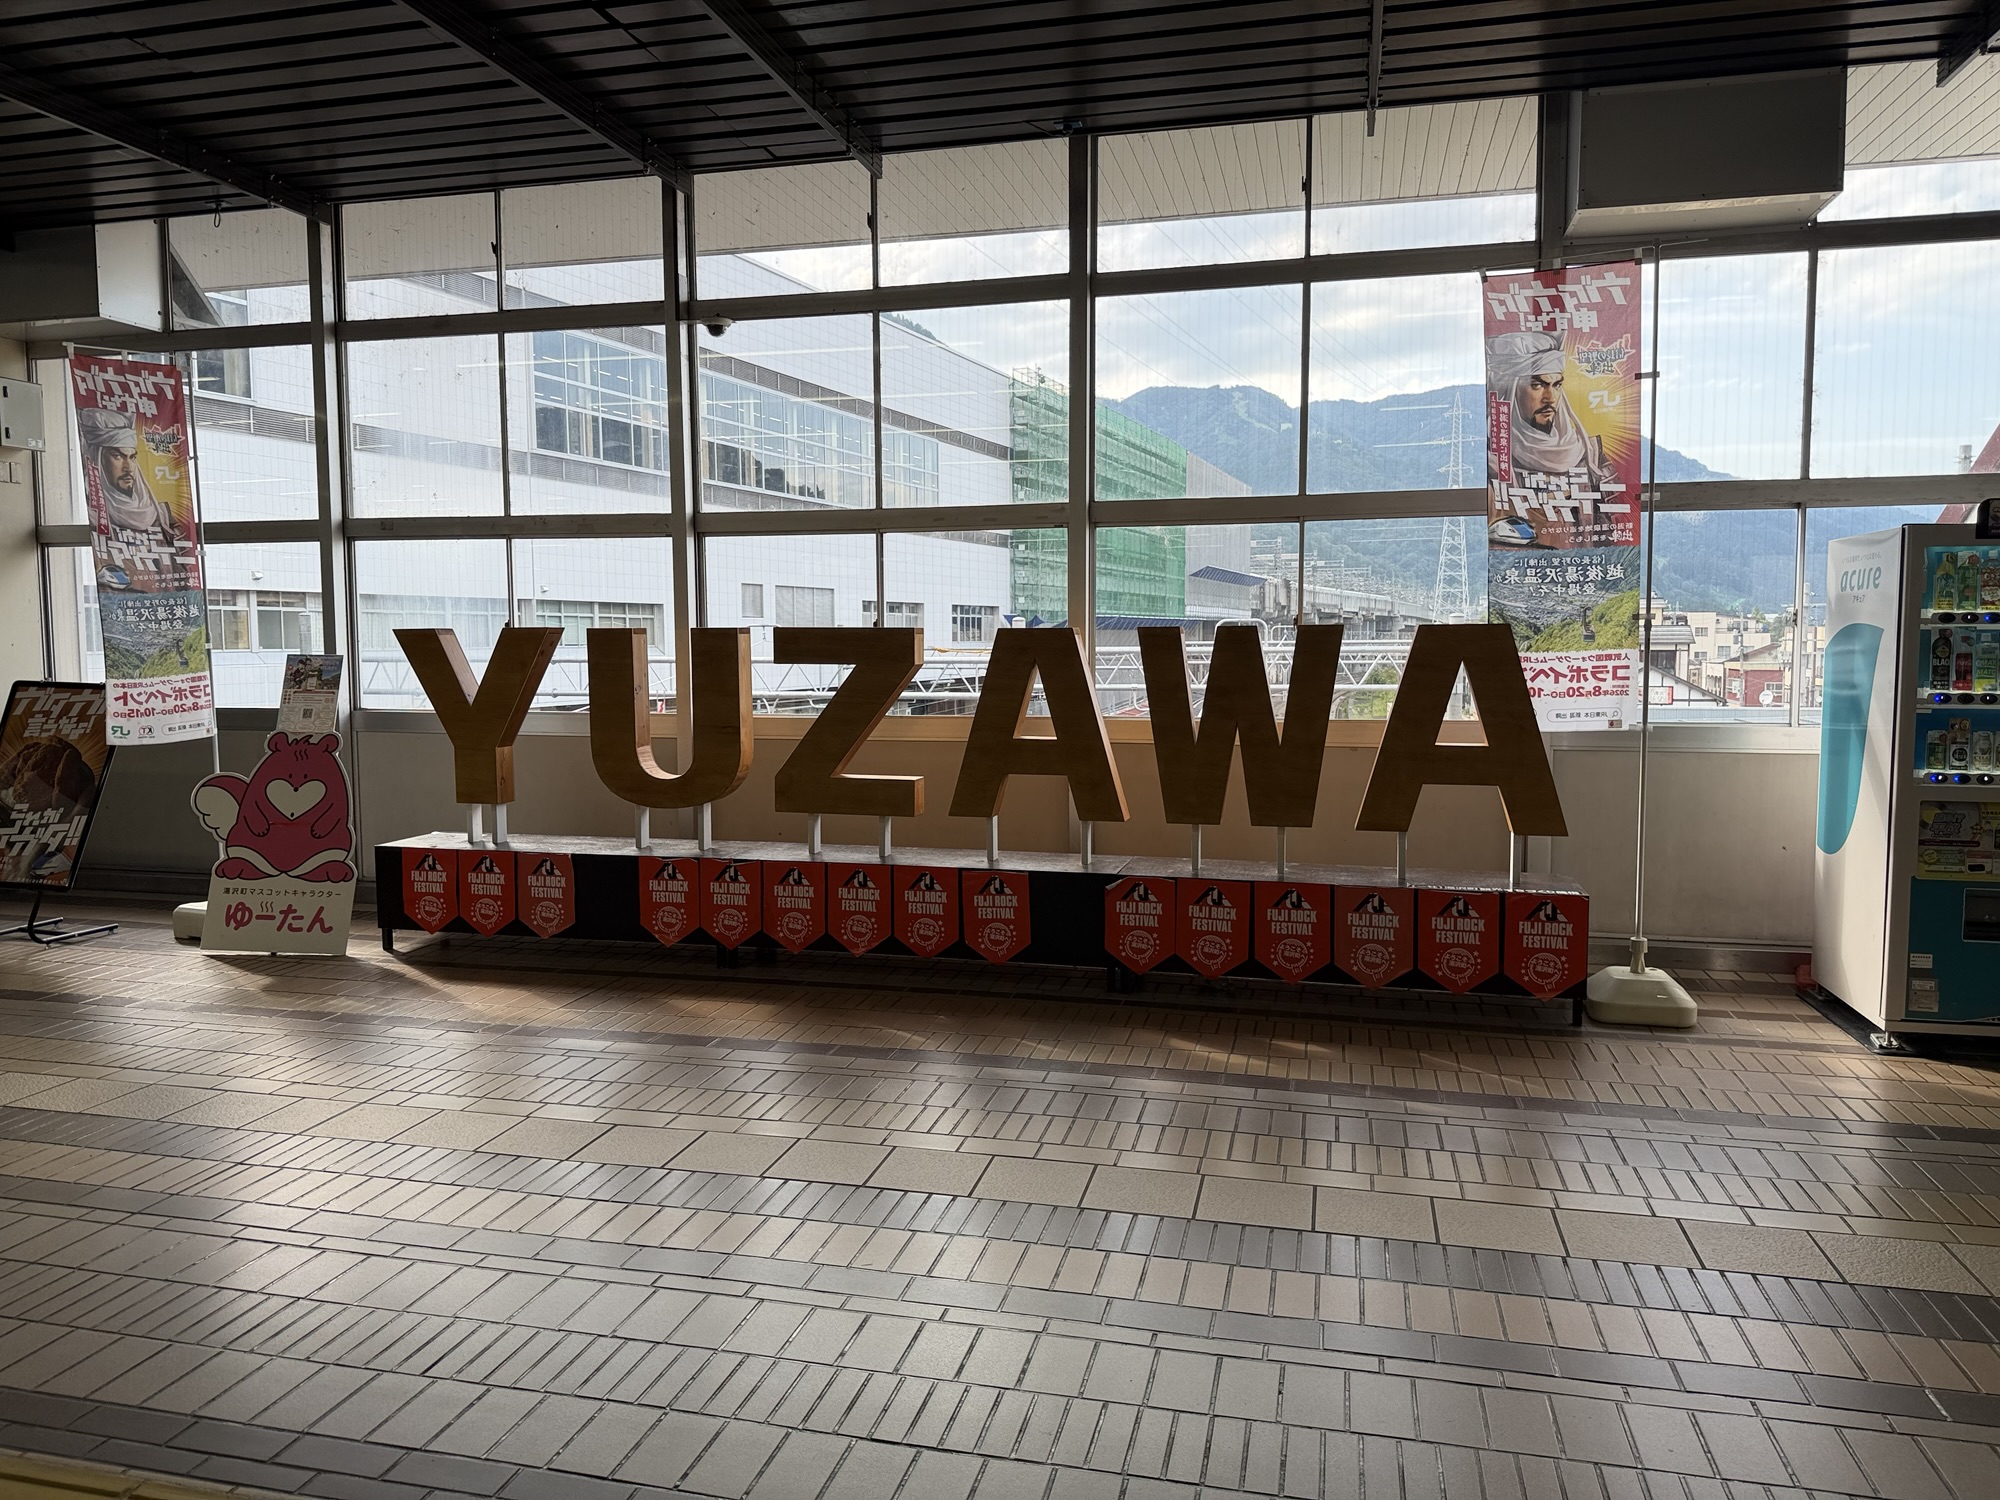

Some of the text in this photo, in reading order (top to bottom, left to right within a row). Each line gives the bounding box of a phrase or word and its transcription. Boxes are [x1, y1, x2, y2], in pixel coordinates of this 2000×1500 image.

[1841, 566, 1882, 592] acure
[12, 686, 106, 718] ガタガ
[392, 624, 1569, 837] YUZAWA
[411, 870, 447, 882] FUJI ROCK
[468, 872, 505, 885] FUJI ROCK
[528, 876, 566, 887] FUJI ROCK
[222, 887, 342, 898] 湯沢町マスコットキャラクター
[414, 882, 444, 893] FESTIVAL
[471, 884, 502, 896] FESTIVAL
[531, 887, 563, 898] FESTIVAL
[649, 880, 688, 892] FUJI ROCK
[710, 882, 750, 894] FUJI ROCK
[774, 885, 814, 898] FUJI ROCK
[653, 892, 685, 903] FESTIVAL
[714, 894, 747, 906] FESTIVAL
[838, 888, 880, 900] FUJI ROCK
[905, 890, 947, 903] FUJI ROCK
[778, 898, 811, 909] FESTIVAL
[842, 900, 876, 912] FESTIVAL
[974, 895, 1018, 907] FUJI ROCK
[908, 903, 944, 915] FESTIVAL
[978, 907, 1015, 919] FESTIVAL
[1116, 901, 1163, 915] FUJI ROCK
[1189, 905, 1236, 920] FUJI ROCK
[225, 901, 333, 934] ゆーたん
[1120, 914, 1159, 927] FESTIVAL
[1267, 908, 1317, 923] FUJI ROCK
[1347, 913, 1399, 928] FUJI ROCK
[1192, 918, 1232, 932] FESTIVAL
[1271, 922, 1313, 935] FESTIVAL
[1432, 917, 1485, 932] FUJI ROCK
[1519, 921, 1573, 936] FUJI ROCK
[1352, 926, 1395, 941] FESTIVAL
[1436, 931, 1480, 945] FESTIVAL
[1523, 935, 1569, 950] FESTIVAL
